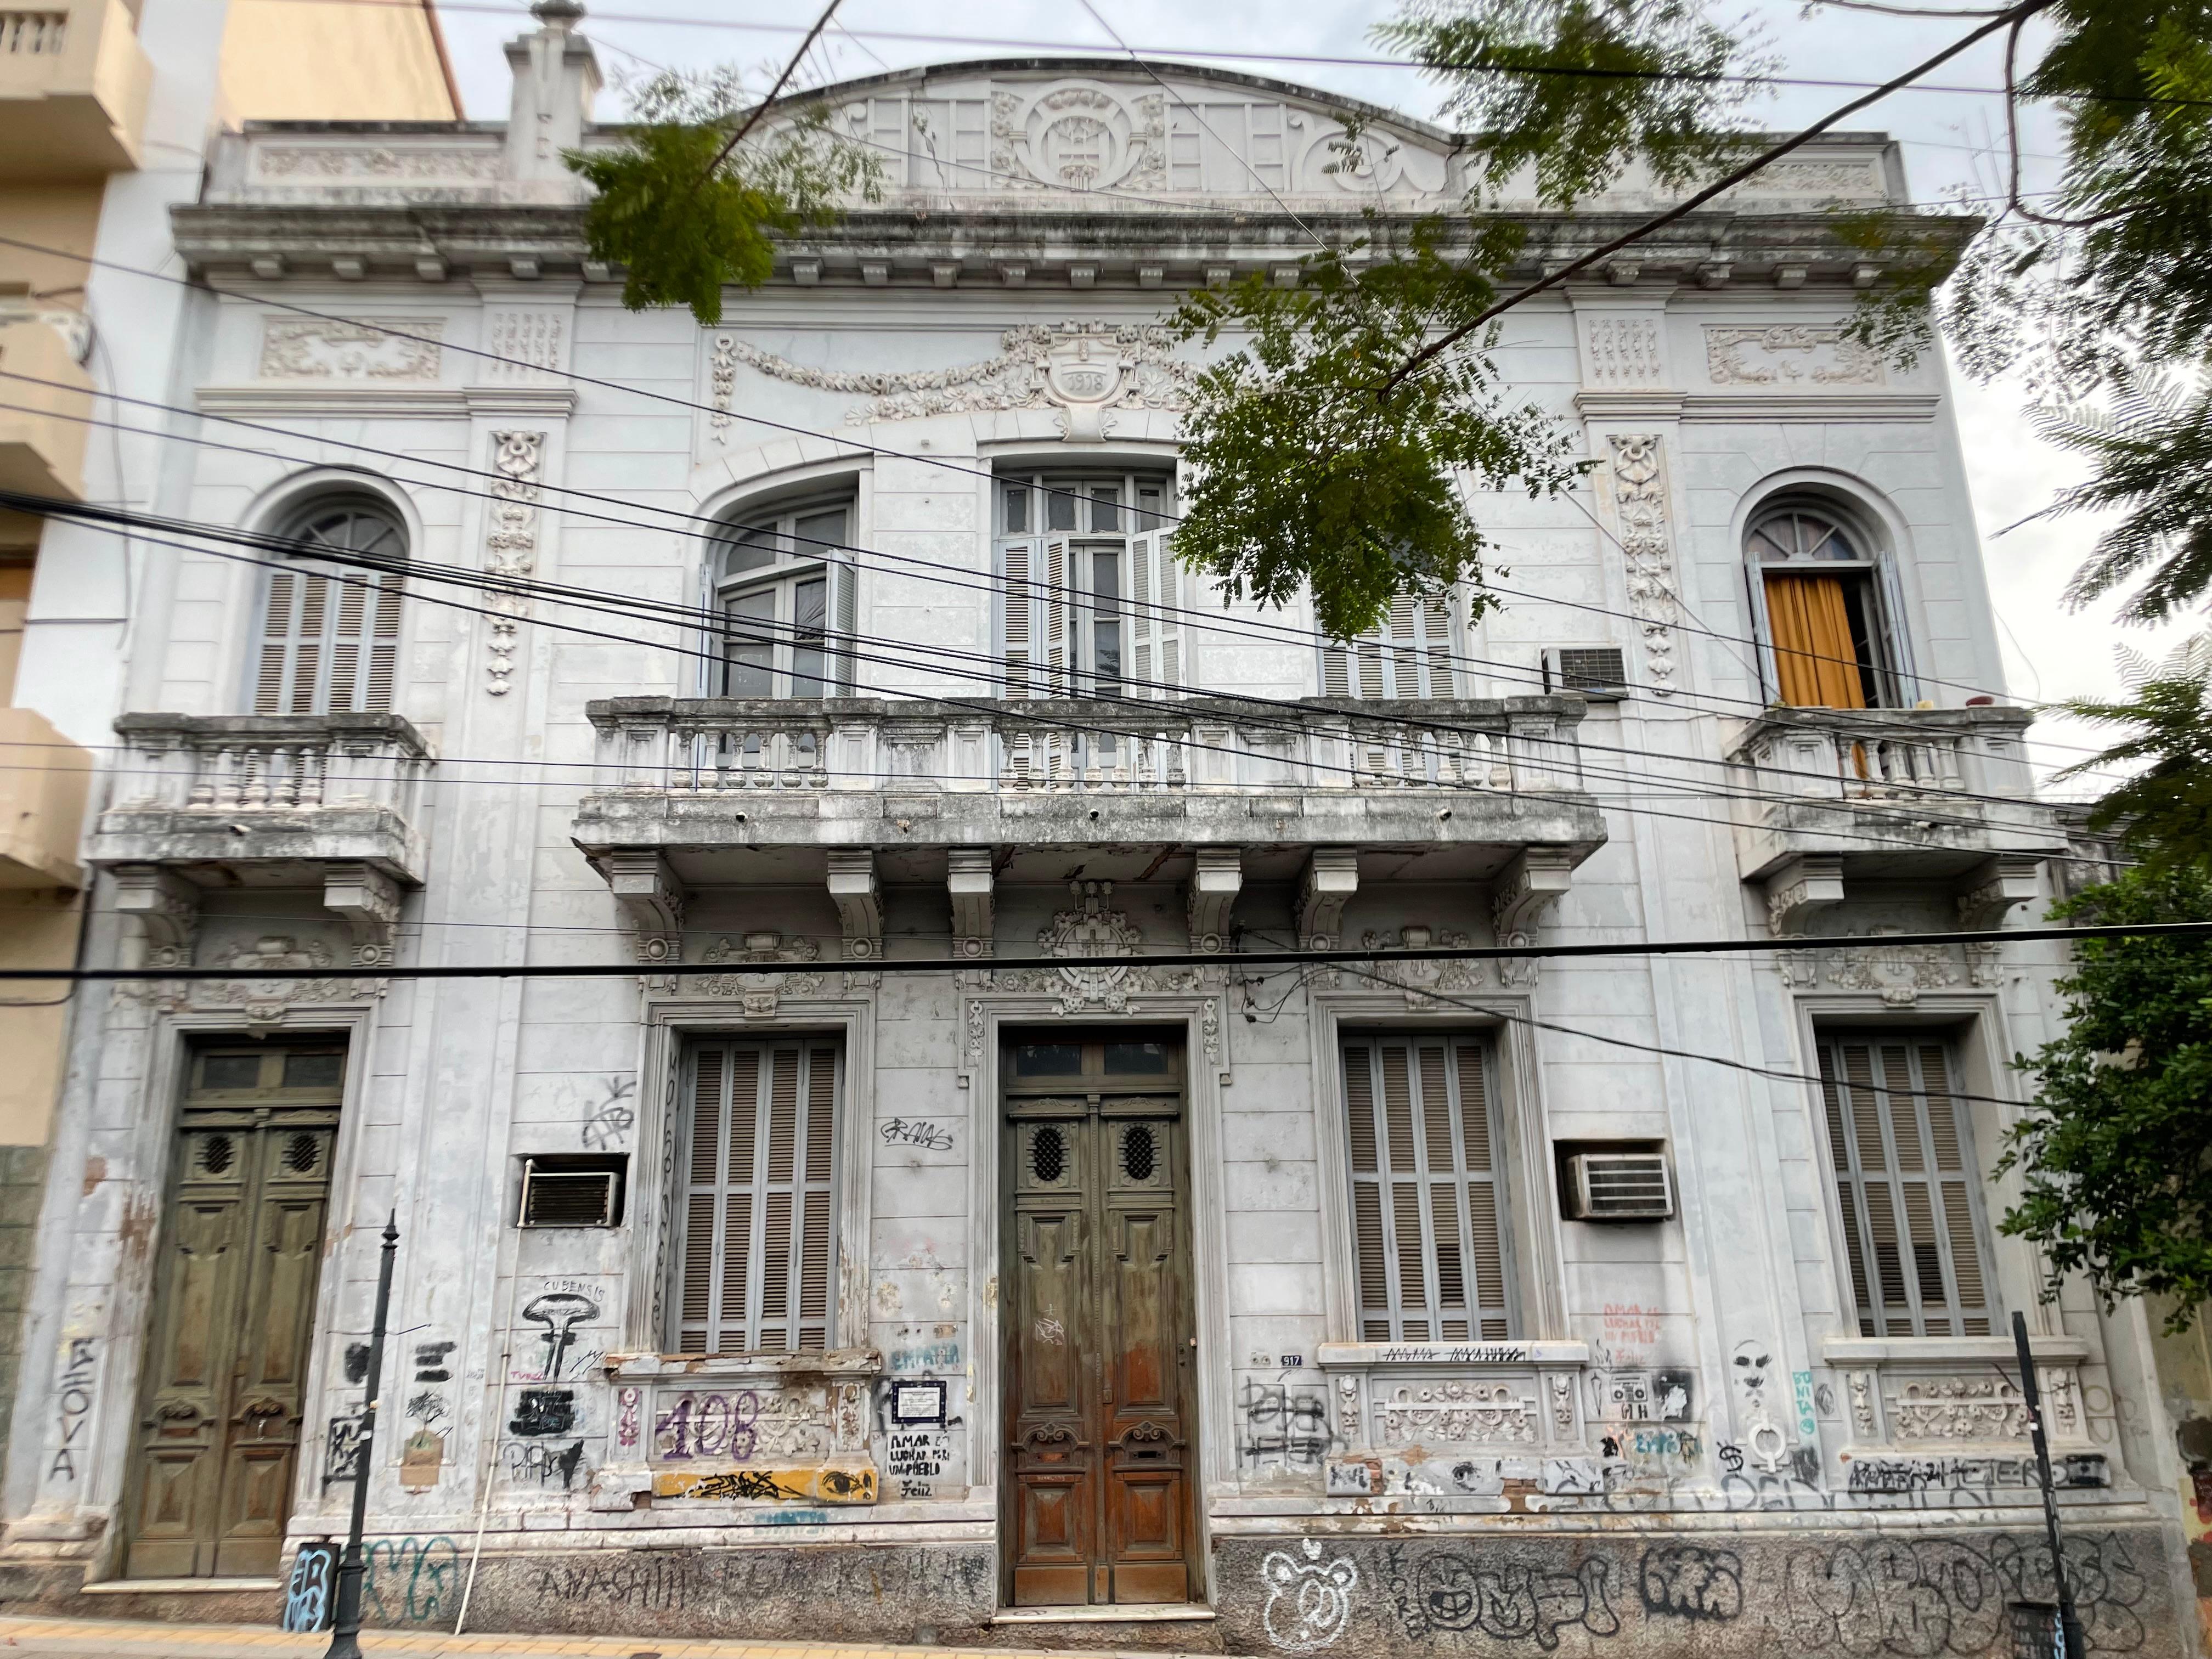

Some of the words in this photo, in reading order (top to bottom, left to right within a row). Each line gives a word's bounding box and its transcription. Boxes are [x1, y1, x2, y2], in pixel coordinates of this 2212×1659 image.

[1068, 374, 1103, 391] 1918
[544, 1281, 605, 1302] CUBENSIS
[1283, 1356, 1301, 1365] 917
[891, 1435, 930, 1449] AMAR
